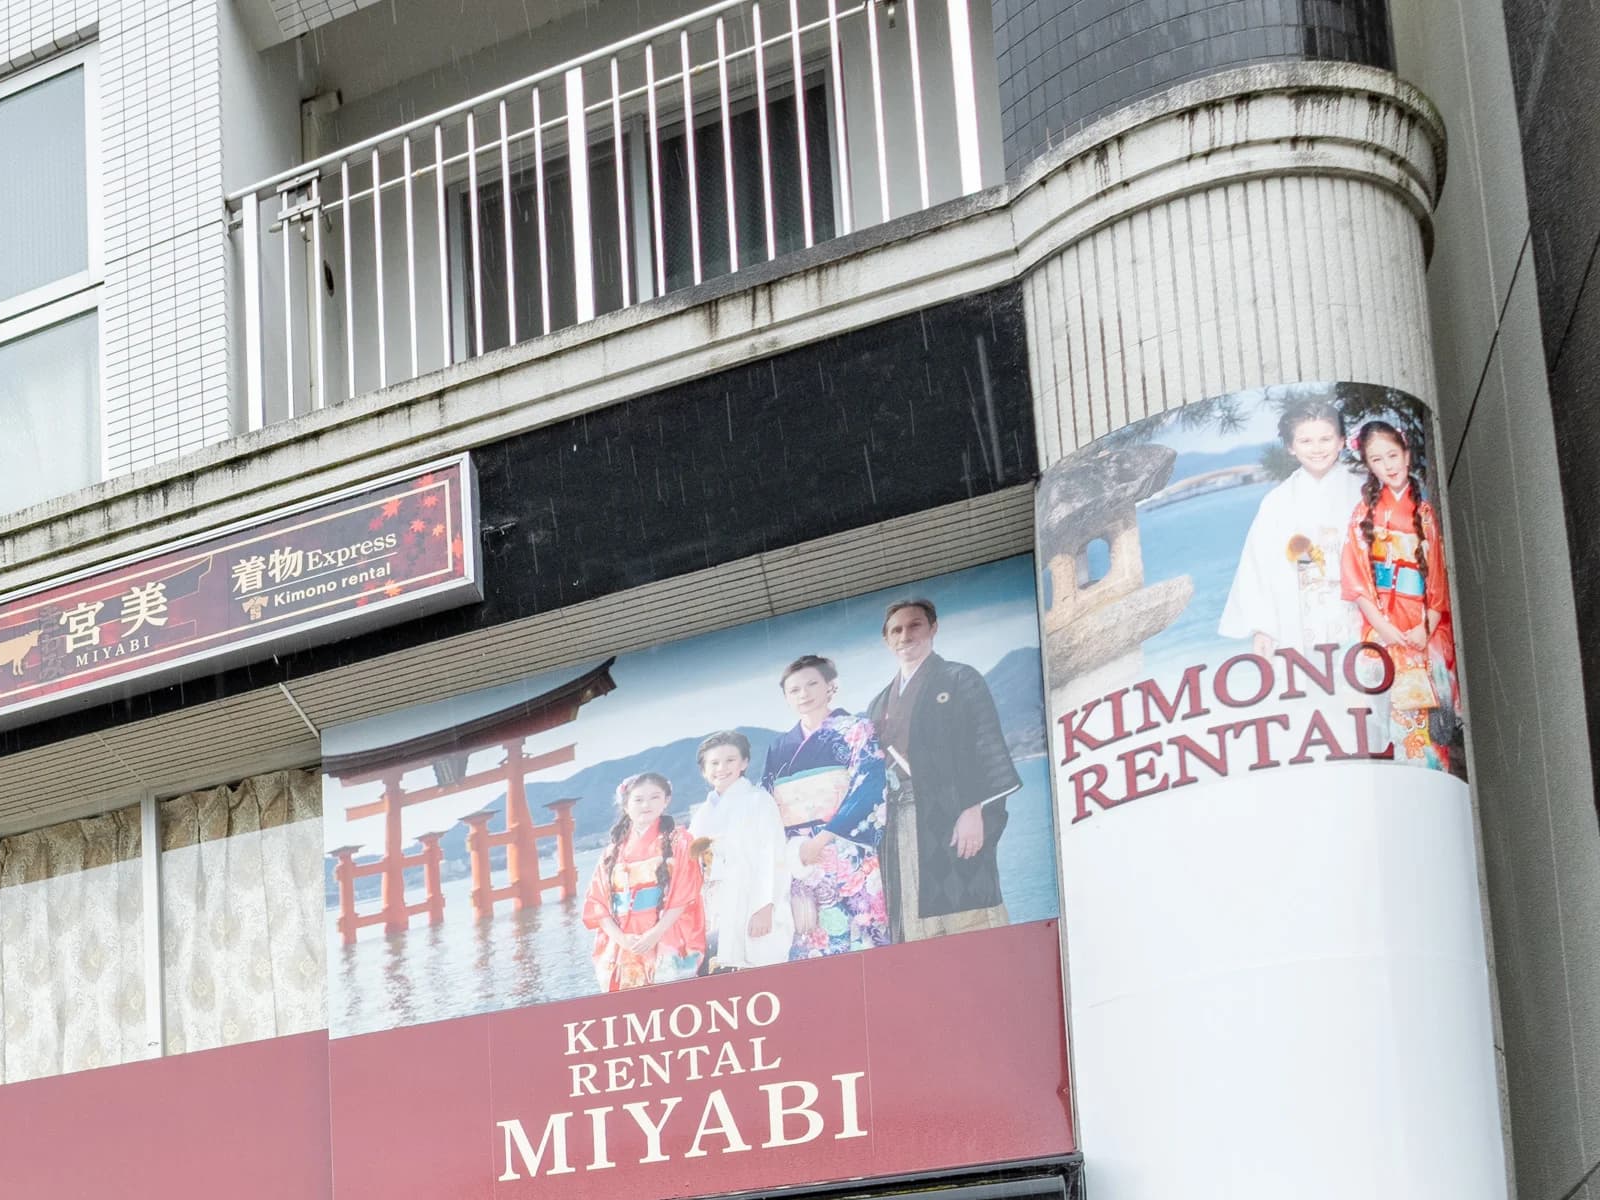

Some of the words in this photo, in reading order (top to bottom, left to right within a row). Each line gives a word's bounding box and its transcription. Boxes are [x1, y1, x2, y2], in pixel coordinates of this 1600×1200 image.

[59, 581, 168, 654] 宮美
[274, 579, 337, 607] Kimono
[342, 563, 391, 588] rental
[76, 635, 150, 668] MIYABI
[1058, 641, 1395, 766] KIMONO
[1068, 707, 1395, 825] RENTAL
[563, 991, 781, 1056] KIMONO
[568, 1036, 782, 1098] RENTAL
[496, 1071, 869, 1182] MIYABI
